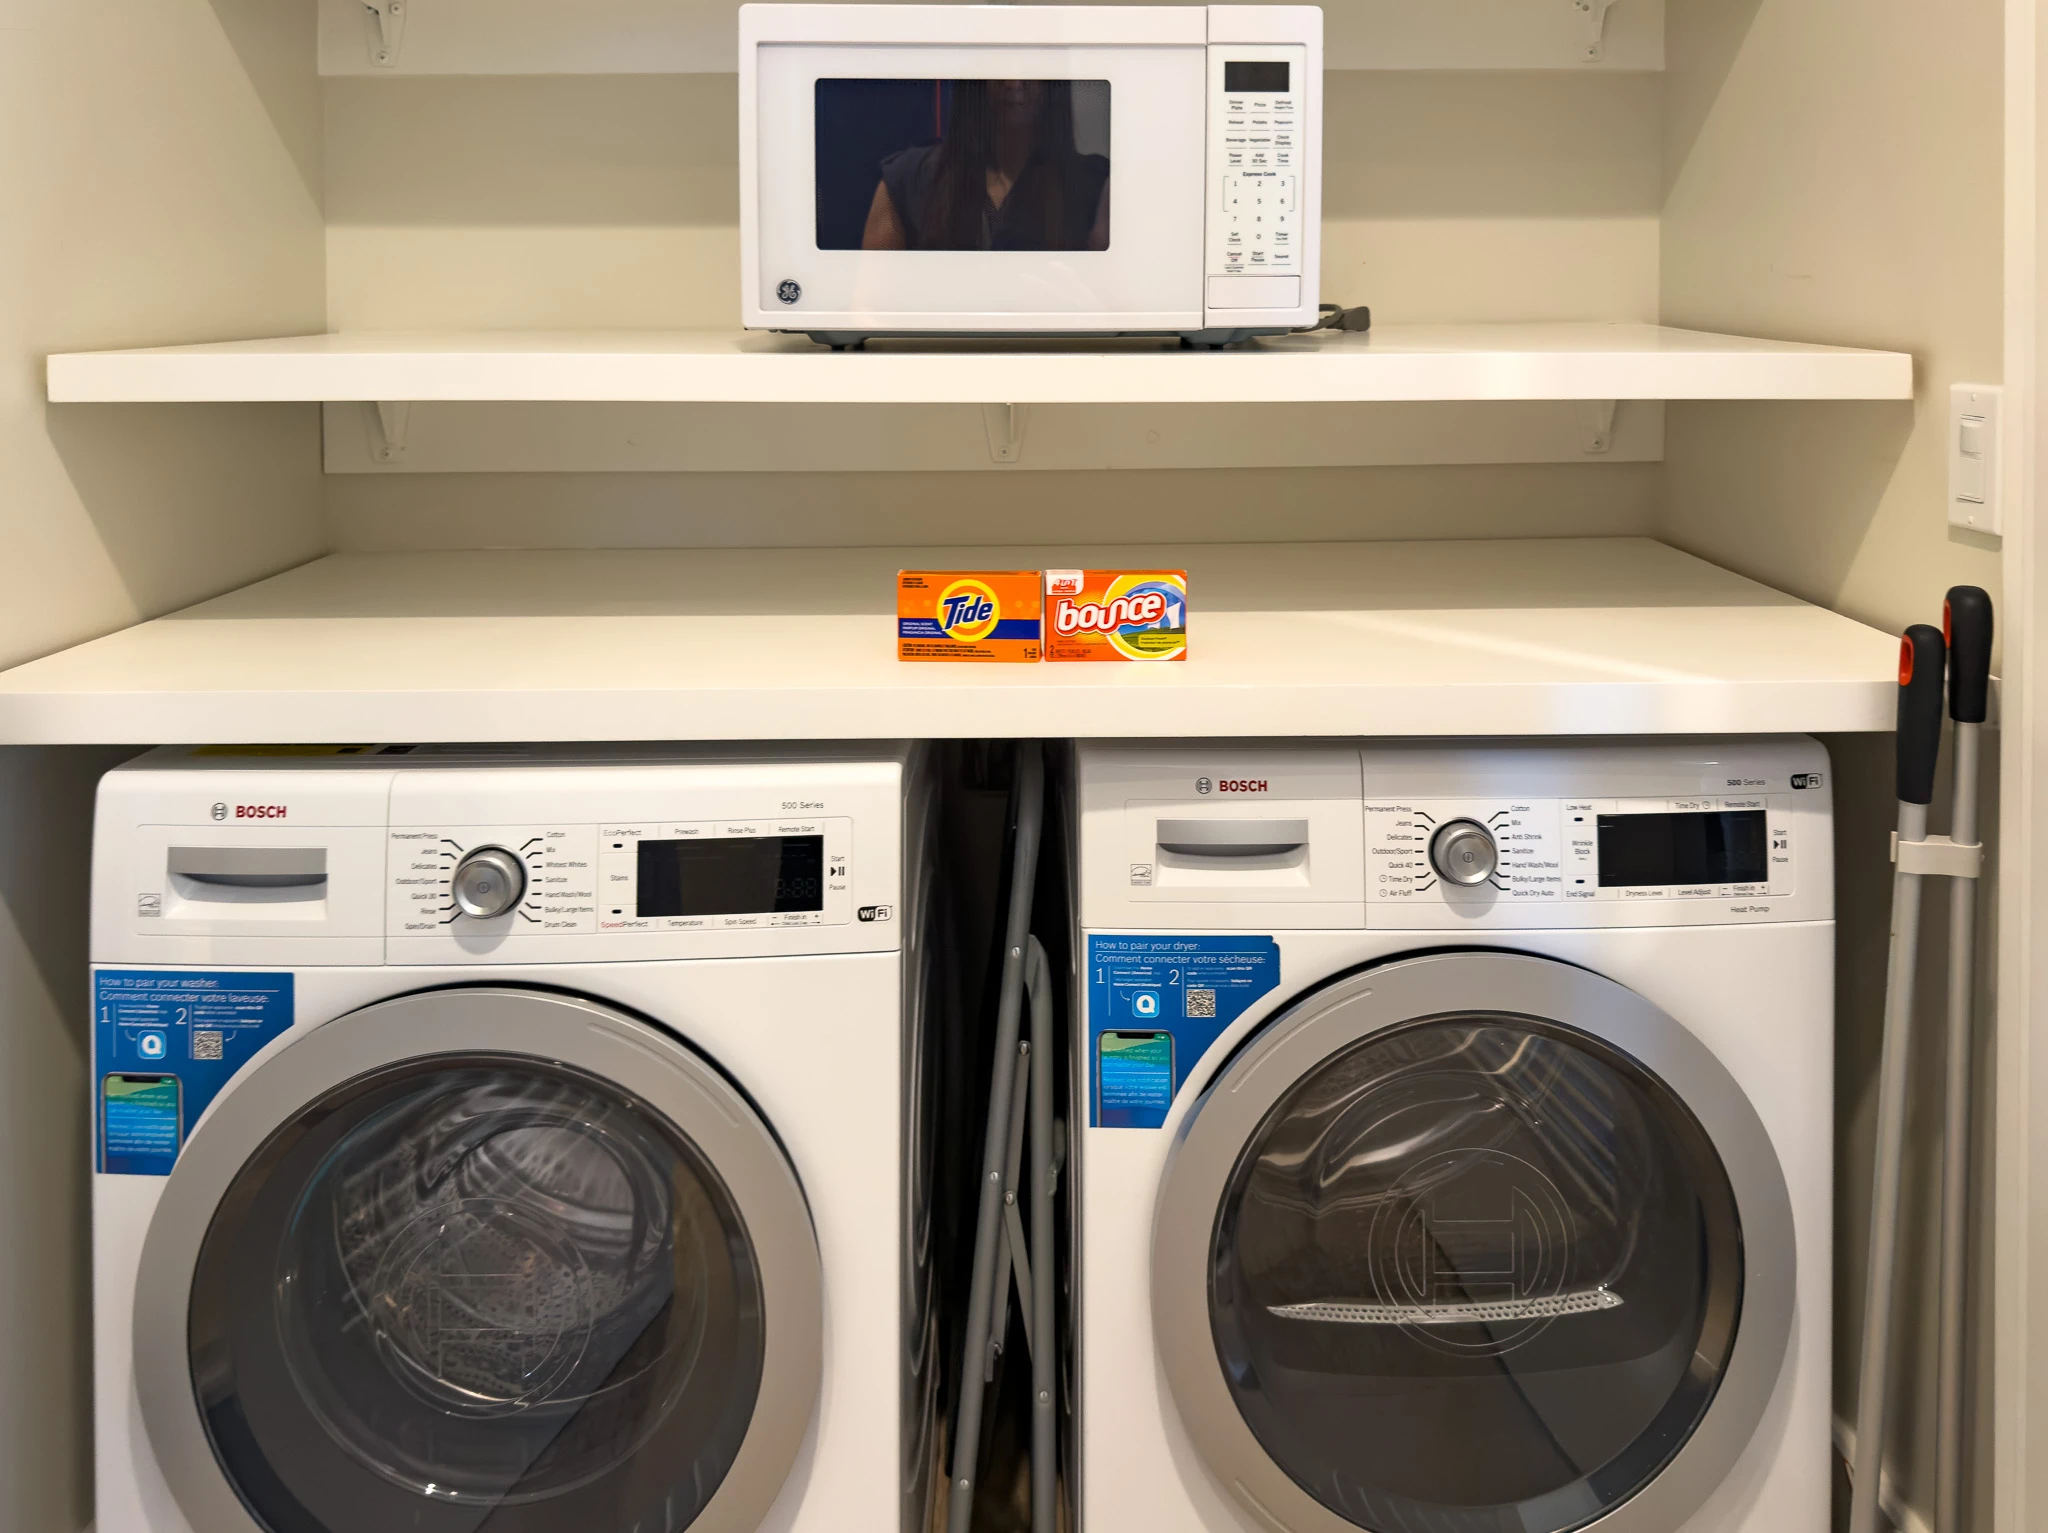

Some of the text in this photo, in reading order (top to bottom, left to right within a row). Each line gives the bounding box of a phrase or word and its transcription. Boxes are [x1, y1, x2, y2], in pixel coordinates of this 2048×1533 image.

[942, 595, 994, 631] Tide
[1056, 594, 1164, 634] bounce
[1219, 780, 1268, 792] BOSCH
[1726, 778, 1766, 786] 500 Series
[235, 805, 287, 818] BOSCH
[781, 801, 824, 810] 500 Series
[1675, 802, 1700, 810] Time Dry
[1566, 890, 1596, 898] End Signal
[1678, 888, 1712, 896] Level Adjust
[600, 920, 649, 928] SpeedPerfect
[724, 918, 757, 926] Spin Speed
[1095, 941, 1116, 949] How
[1118, 941, 1129, 950] to
[1130, 942, 1149, 950] pair
[1151, 943, 1171, 952] your
[1095, 953, 1142, 963] Comment
[1143, 956, 1191, 964] connecter
[1193, 956, 1217, 964] votre
[1095, 967, 1106, 984] 1
[1168, 969, 1180, 985] 2
[99, 977, 121, 987] How
[123, 978, 134, 987] to
[135, 979, 156, 989] pair
[157, 980, 179, 989] your
[99, 990, 148, 1001] Comment
[149, 992, 199, 1002] connecter
[201, 993, 227, 1003] votre
[100, 1005, 111, 1023] 1
[175, 1007, 188, 1025] 2
